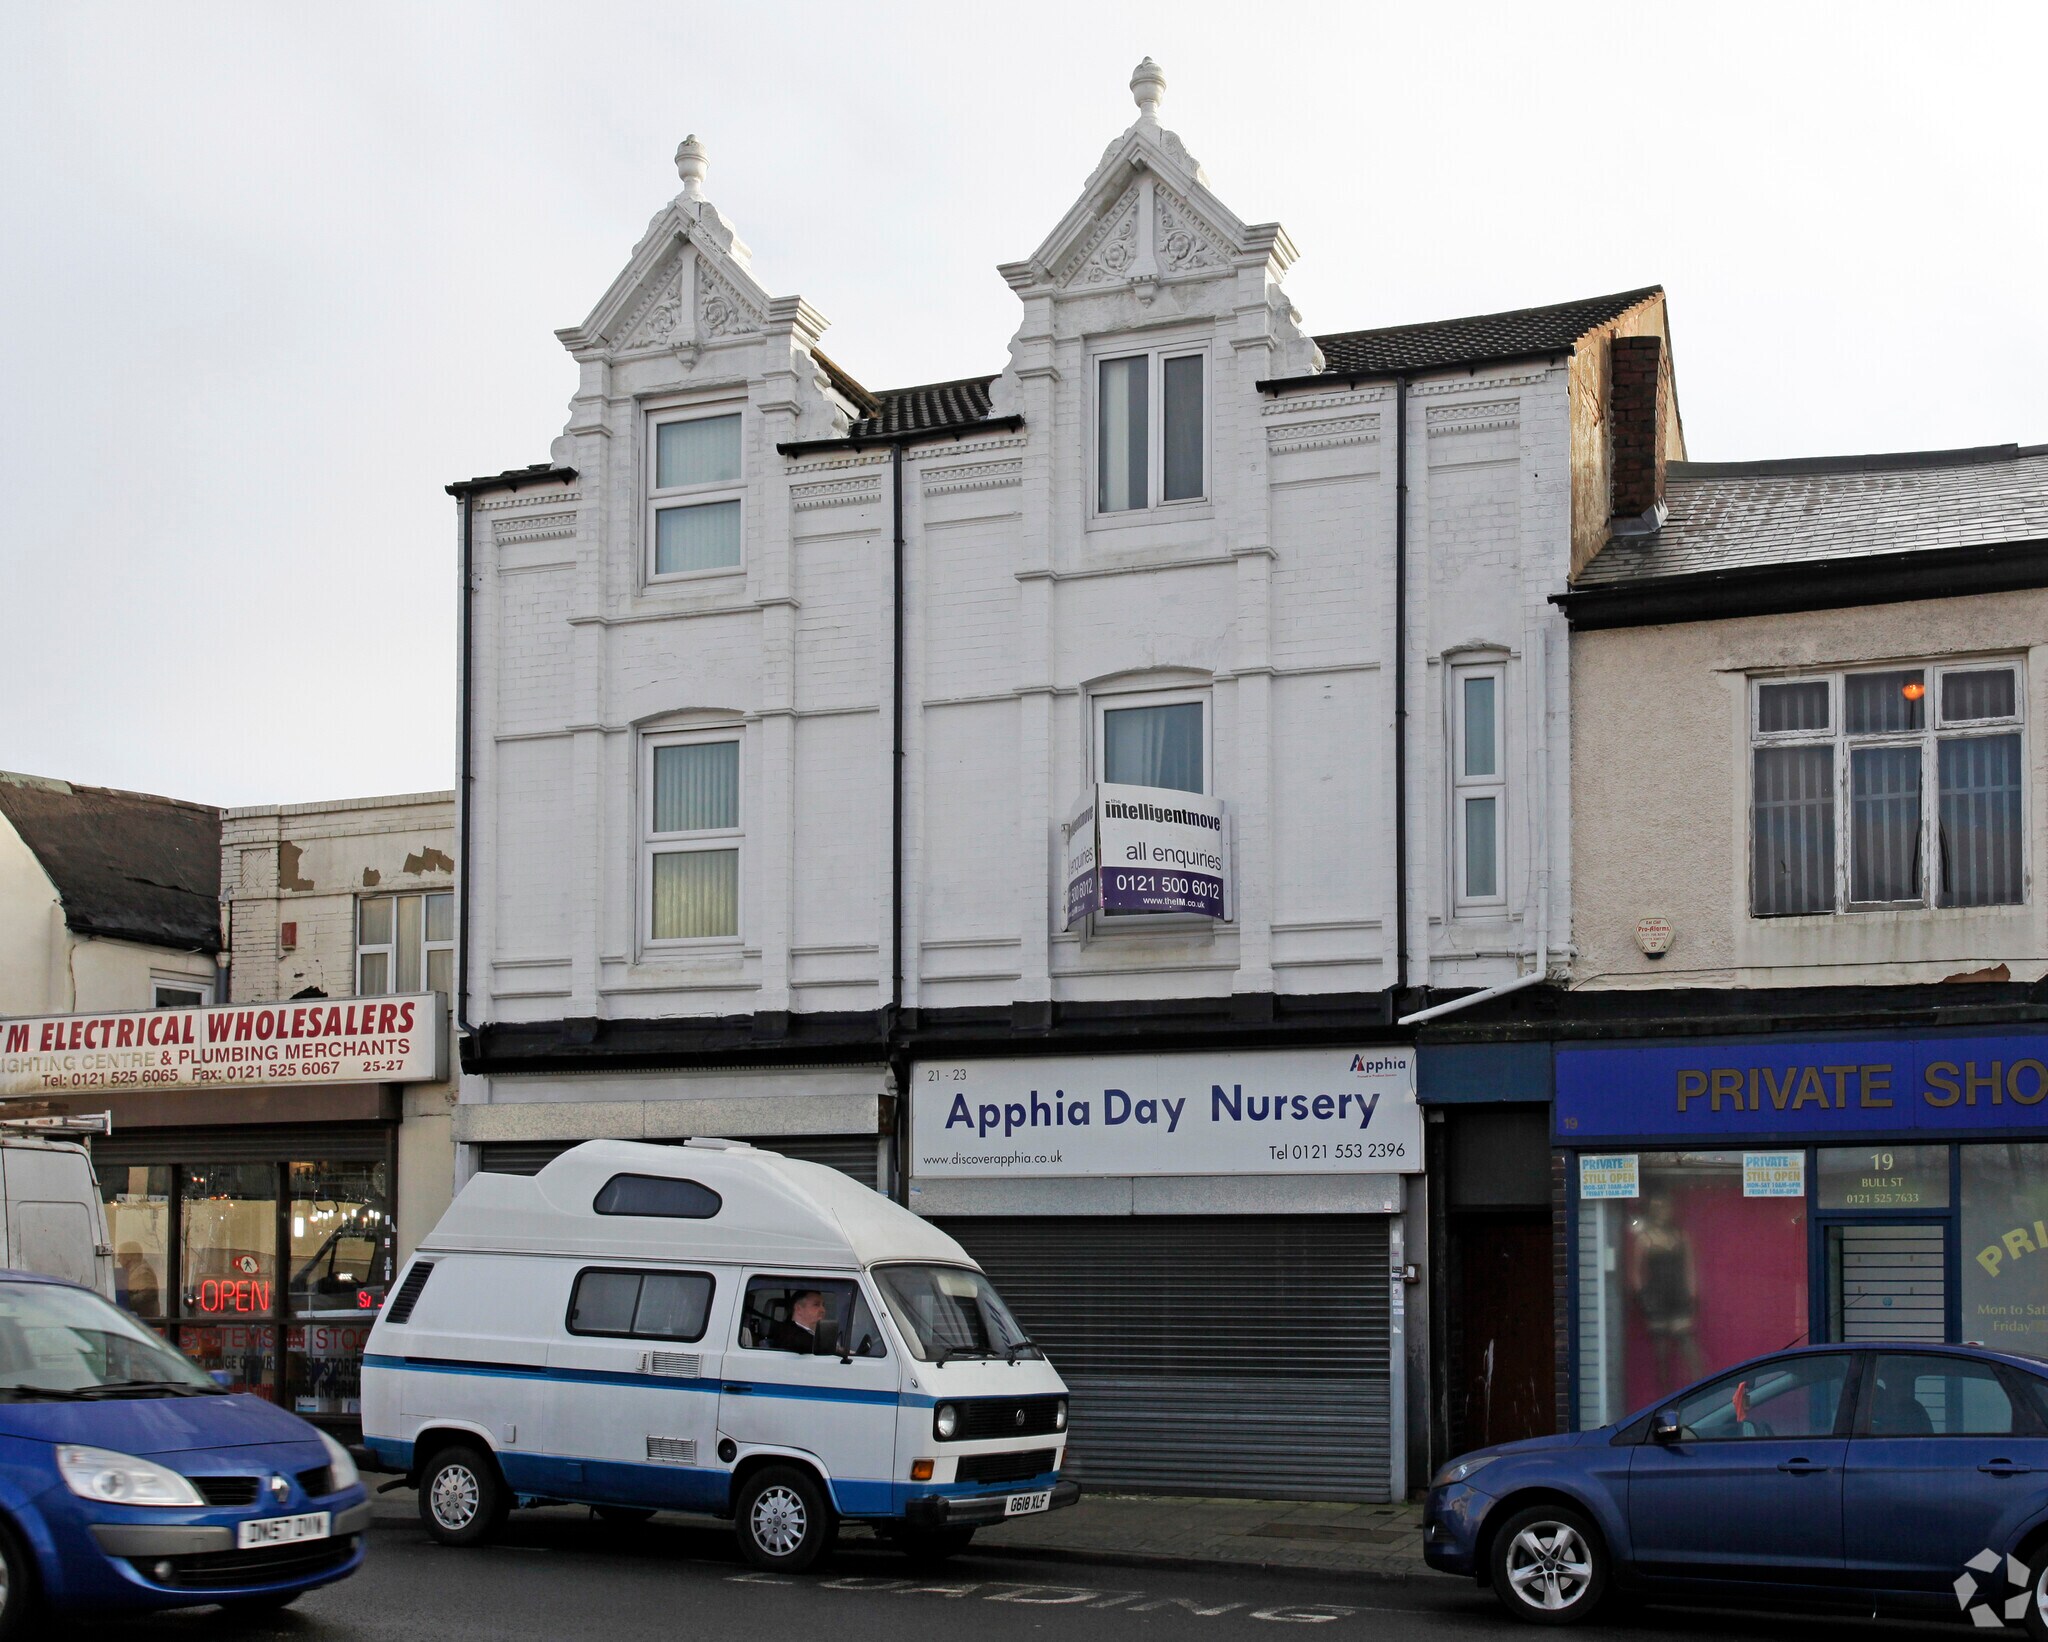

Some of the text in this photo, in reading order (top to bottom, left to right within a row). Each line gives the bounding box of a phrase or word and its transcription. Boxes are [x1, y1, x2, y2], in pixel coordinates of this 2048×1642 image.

[1105, 801, 1221, 831] intelligentmove
[1126, 842, 1222, 871] all enquiries
[1116, 874, 1220, 900] 0121 500 6012
[1142, 896, 1206, 909] www.theIM.co.uk
[0, 1001, 416, 1053] M ELECTRICAL WHOLESALERS
[0, 1038, 411, 1074] IGHTING CENTRE & PLUMBING MERCHANTS
[1349, 1053, 1406, 1074] Apphia
[42, 1060, 404, 1088] Tel: 0121 525 6065 Fax: 0121 525 6067 25-27
[927, 1070, 940, 1081] 21
[952, 1069, 967, 1080] 23
[1676, 1058, 2048, 1112] PRIVATE SHO
[945, 1084, 1381, 1138] Apphia Day Nursery
[1563, 1117, 1578, 1130] 19
[923, 1150, 1063, 1167] www.discoverapphia.co.uk
[1269, 1142, 1406, 1160] Tel 0121 553 2396
[1582, 1158, 1623, 1169] PRIVATE
[1746, 1156, 1789, 1168] PRIVATE
[1870, 1153, 1894, 1171] 19
[1583, 1172, 1635, 1184] STILL OPEN
[1747, 1171, 1801, 1182] STILL OPEN
[1861, 1177, 1904, 1187] BULL ST
[1846, 1193, 1919, 1204] 0121 525 7633
[1976, 1220, 2048, 1278] PRI
[201, 1279, 270, 1311] OPEN
[1977, 1304, 2006, 1315] Mon
[2010, 1305, 2023, 1315] to
[1993, 1320, 2031, 1334] Friday
[179, 1326, 275, 1349] SYSTEMS
[287, 1328, 305, 1348] IN
[315, 1327, 370, 1350] STOC
[1031, 1494, 1047, 1509] XLF
